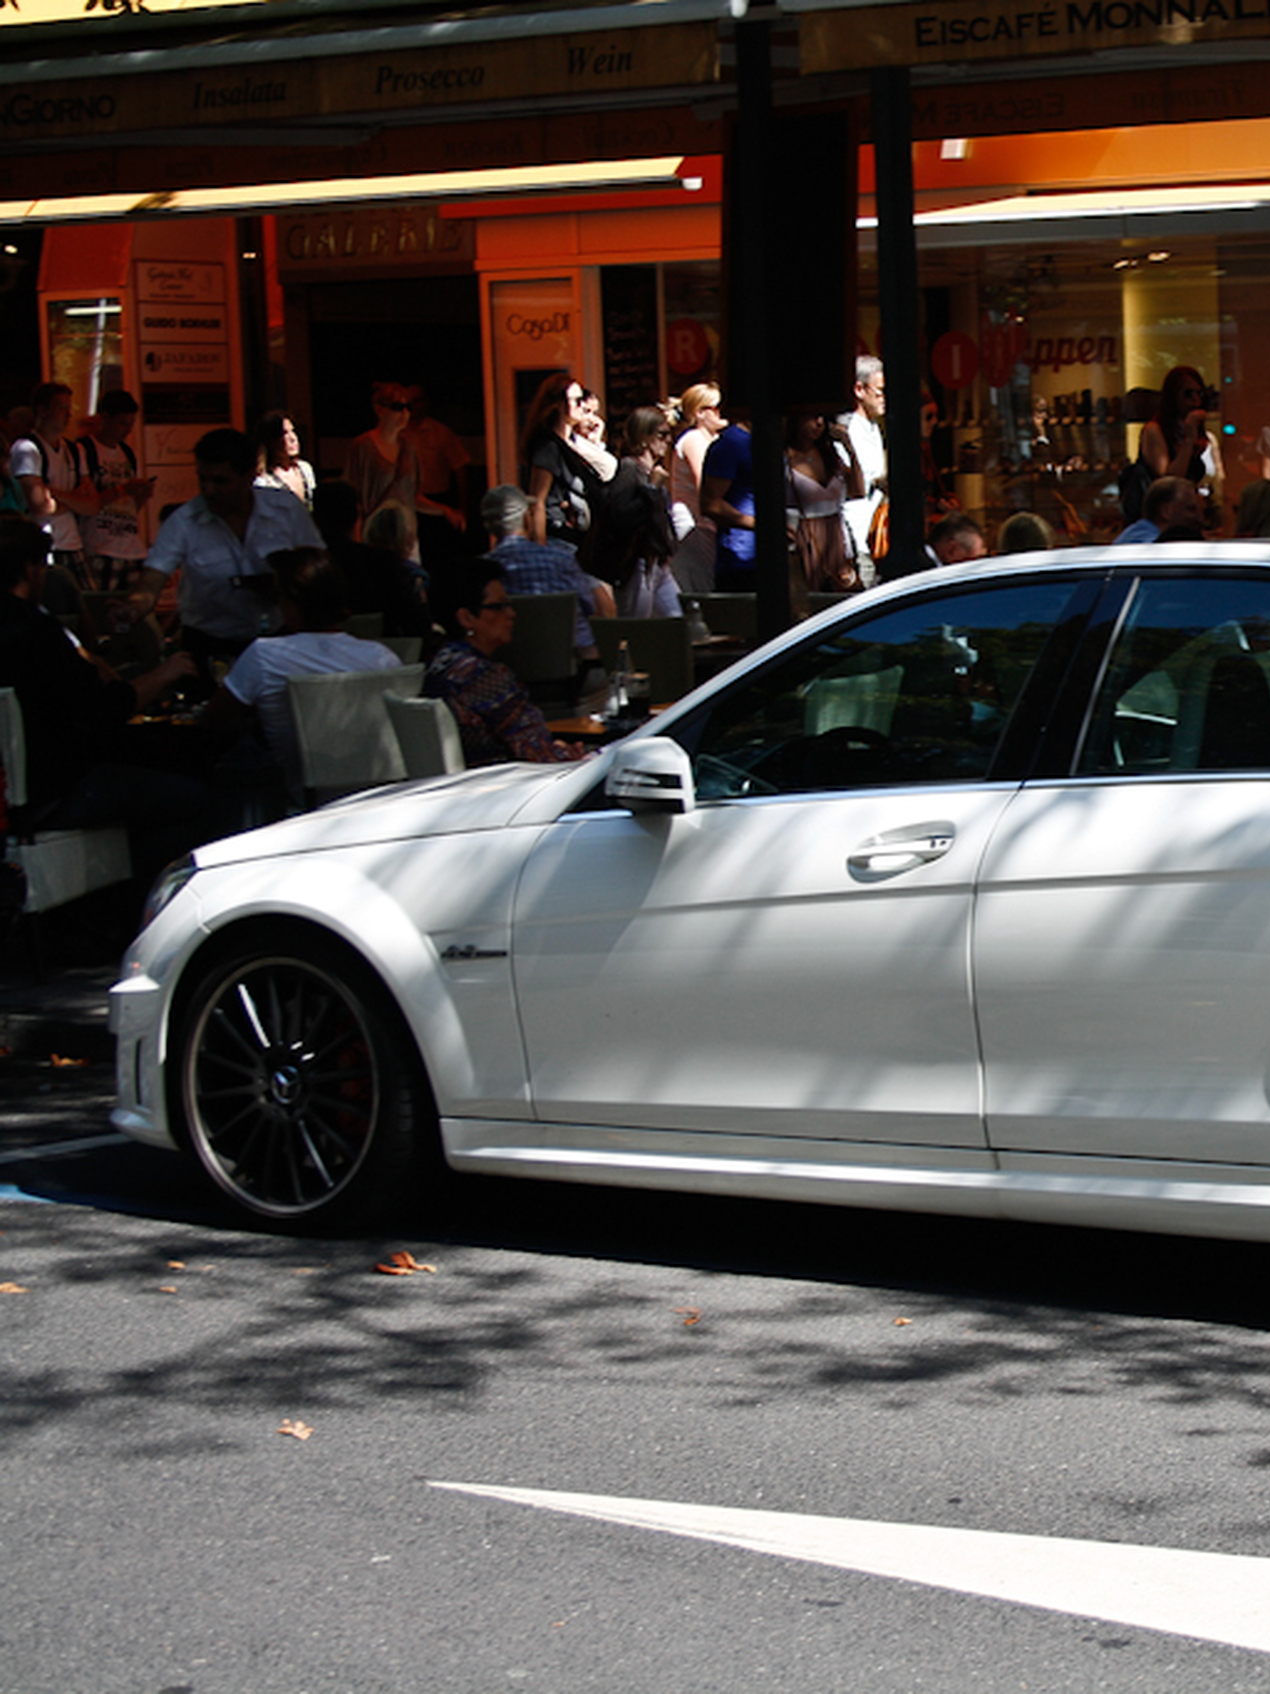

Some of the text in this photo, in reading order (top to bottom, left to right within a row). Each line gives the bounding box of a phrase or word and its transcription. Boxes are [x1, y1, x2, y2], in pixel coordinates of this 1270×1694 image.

[915, 4, 1057, 47] EISCAFÉ
[566, 45, 632, 75] Wein
[192, 77, 287, 110] Insalata
[374, 65, 485, 94] Prosecco
